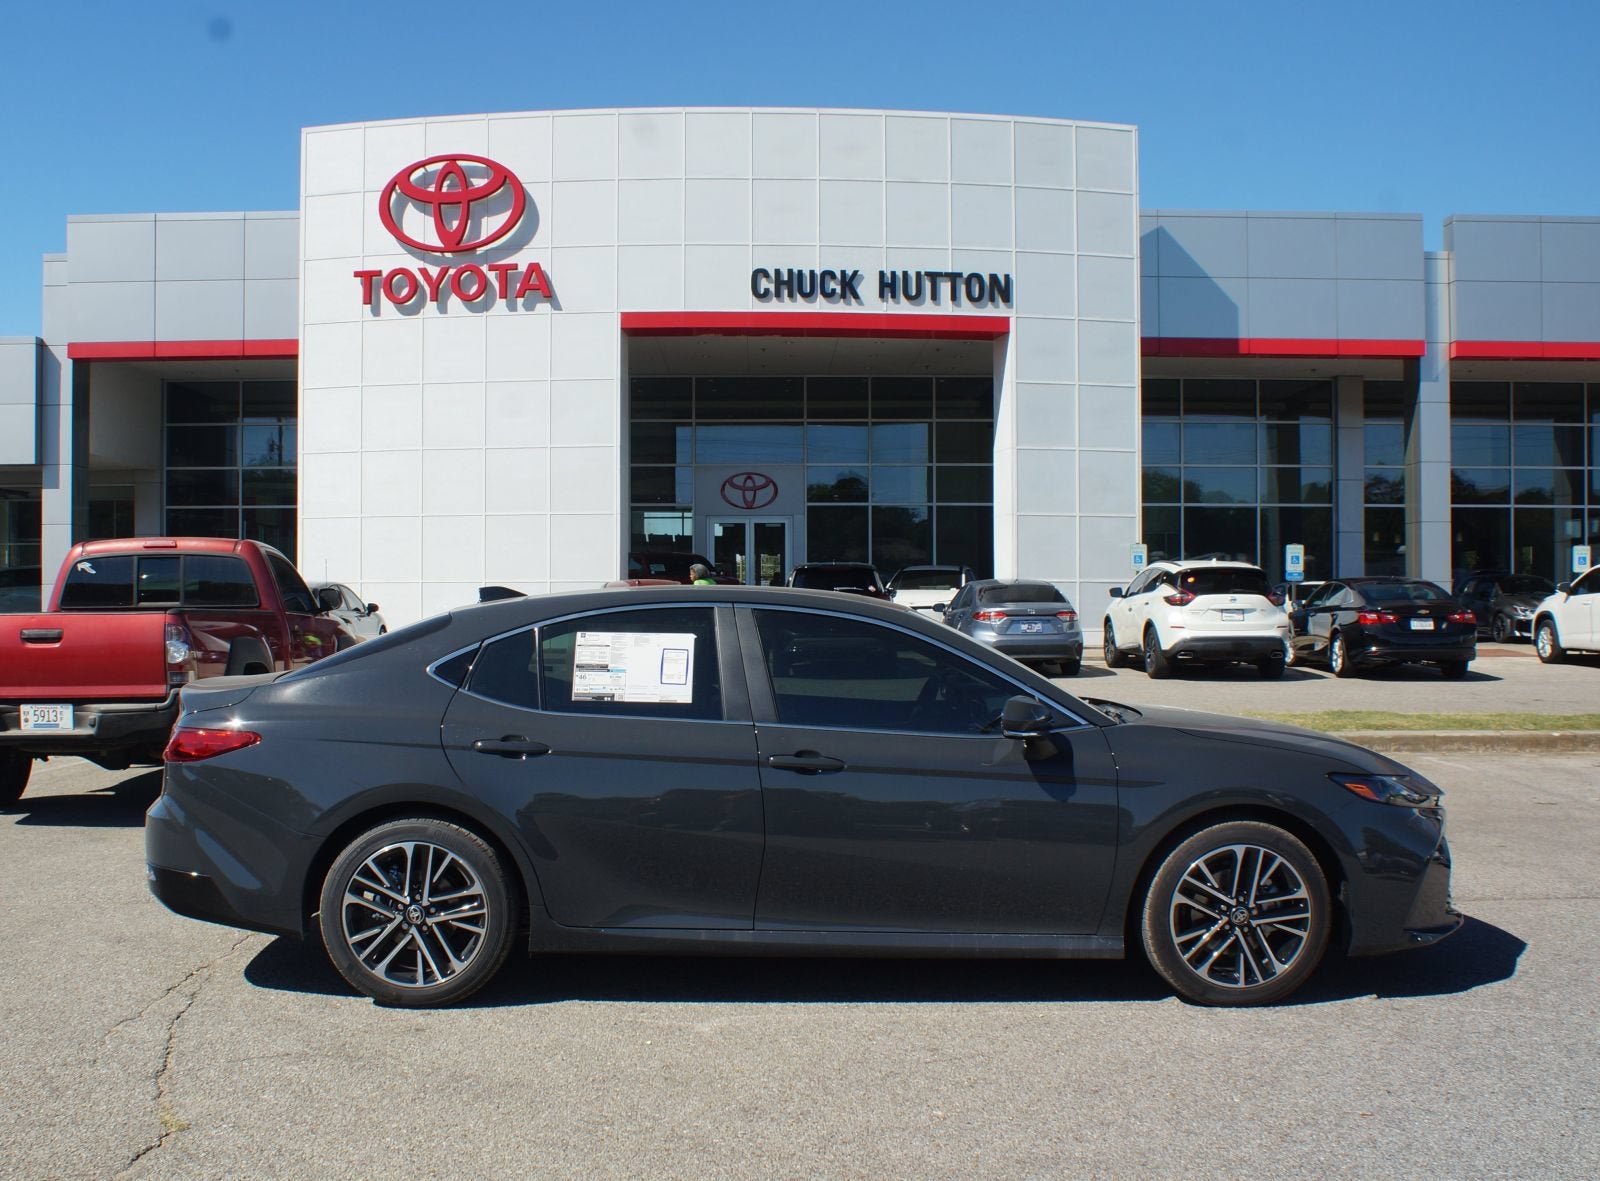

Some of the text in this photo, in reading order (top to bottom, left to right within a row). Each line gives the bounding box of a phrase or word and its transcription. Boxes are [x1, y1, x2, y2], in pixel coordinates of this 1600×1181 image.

[354, 262, 551, 304] TOYOTA
[751, 268, 1011, 303] CHUCK HUTTON
[33, 709, 58, 722] 5913
